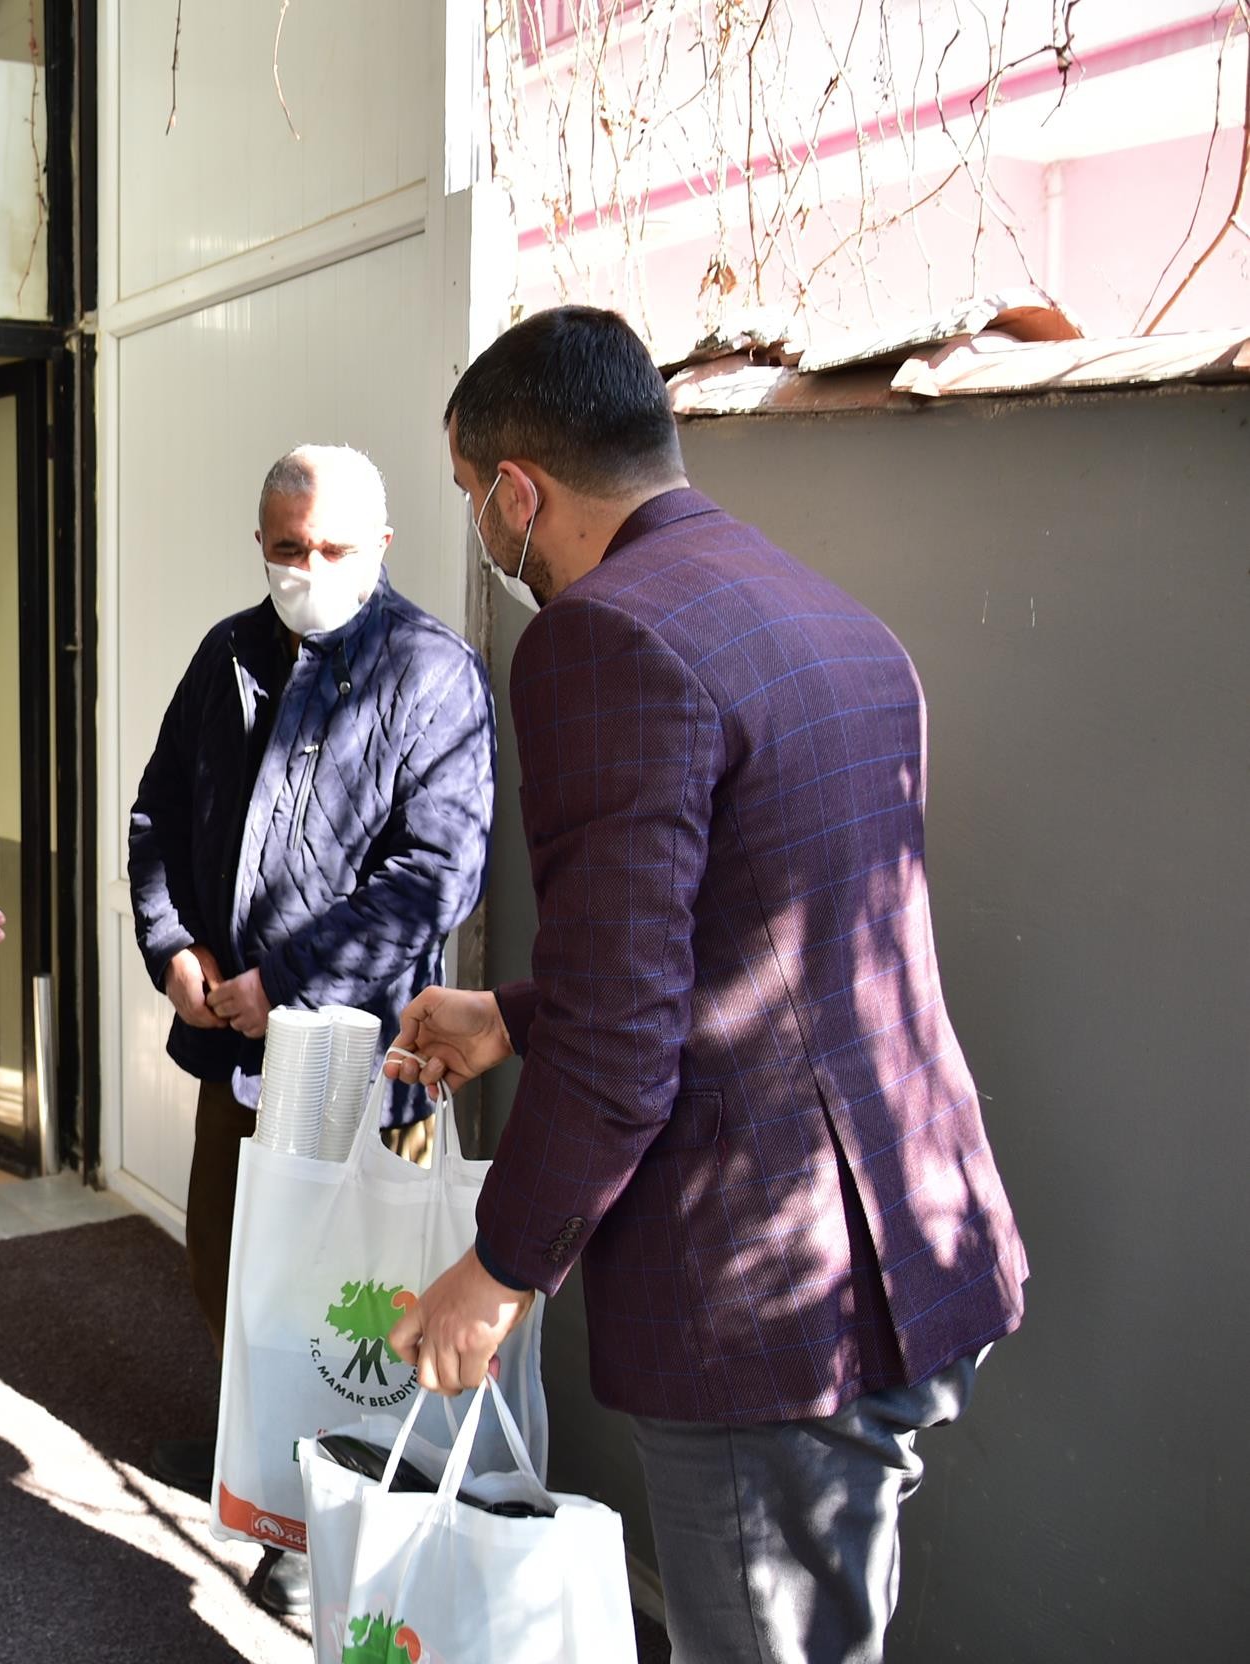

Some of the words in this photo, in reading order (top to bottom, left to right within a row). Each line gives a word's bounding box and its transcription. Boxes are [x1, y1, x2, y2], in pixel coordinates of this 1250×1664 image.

[310, 1337, 321, 1363] T.C.
[317, 1365, 365, 1406] MAMAK
[369, 1363, 418, 1407] BELEDİYE
